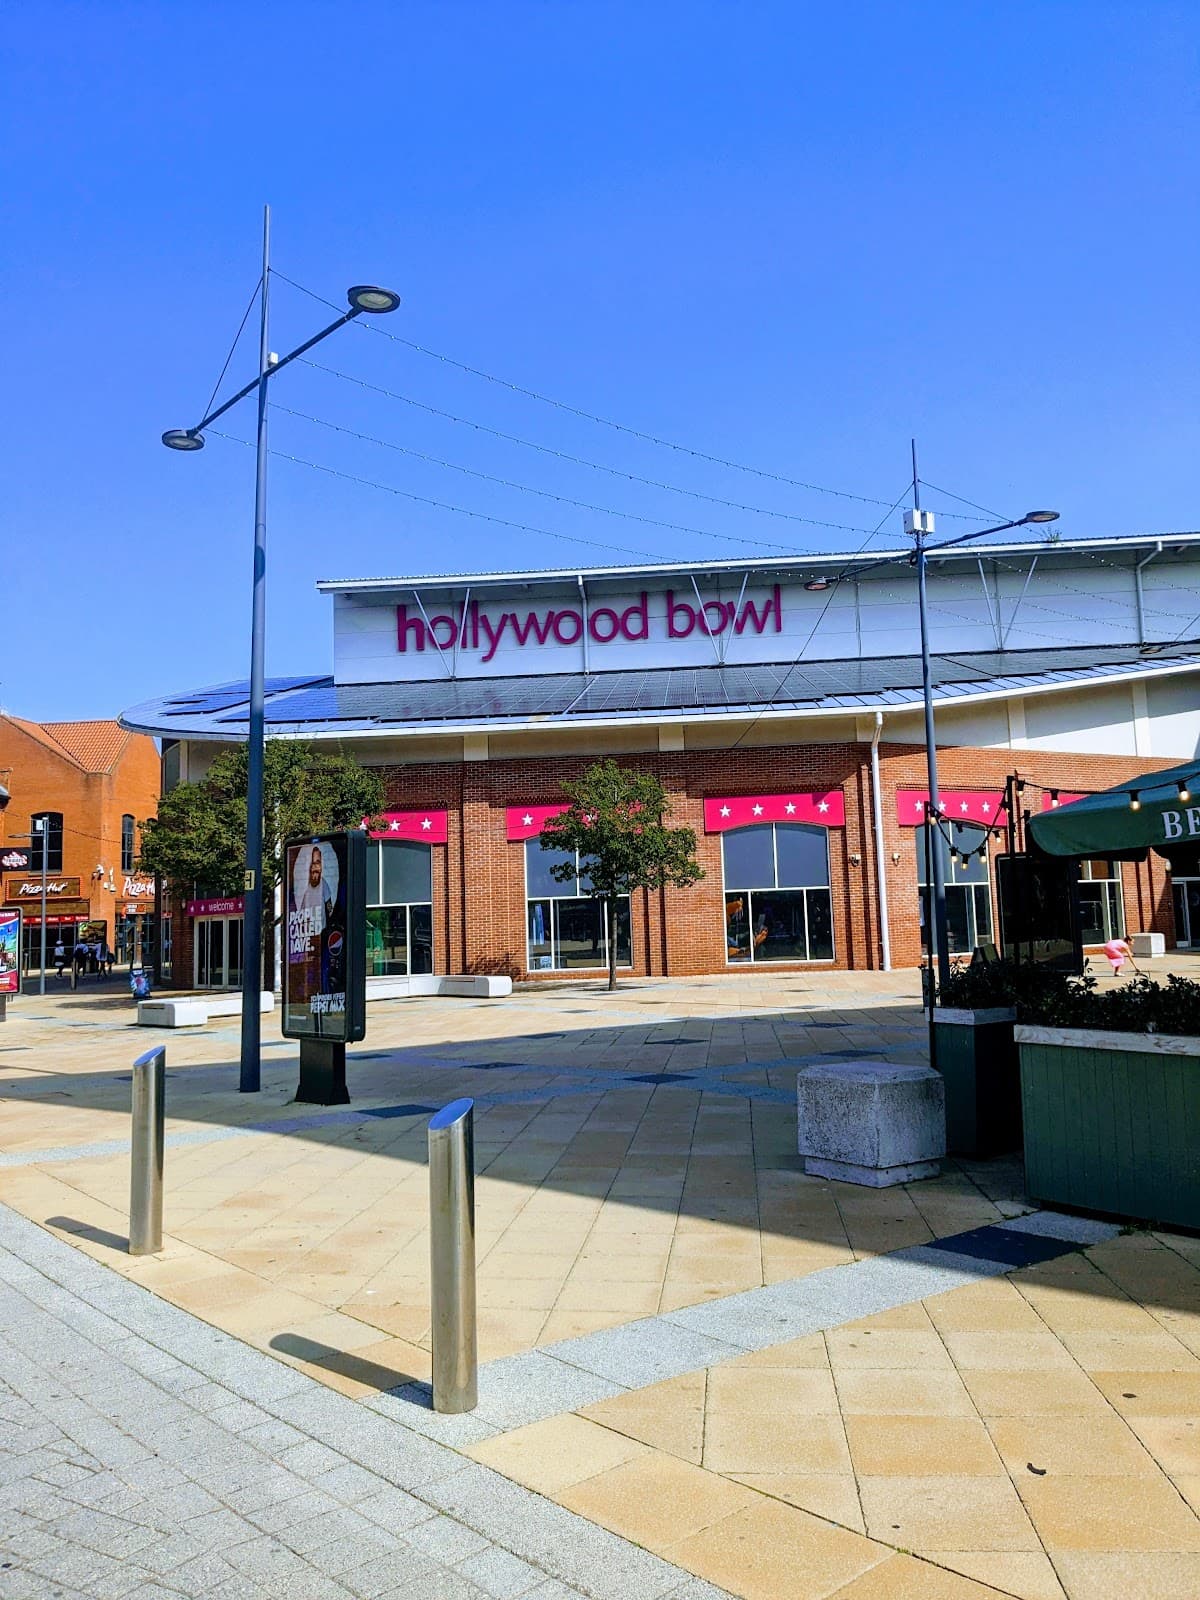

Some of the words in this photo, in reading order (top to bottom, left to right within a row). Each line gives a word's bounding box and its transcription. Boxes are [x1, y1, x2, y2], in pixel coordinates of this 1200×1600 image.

[396, 591, 649, 662] hollywood
[666, 583, 782, 638] bowl
[46, 882, 64, 893] Hut
[122, 876, 145, 897] Pizza
[208, 901, 235, 912] welcome
[289, 905, 322, 925] PEOPLE
[289, 921, 323, 940] CALLED
[329, 1000, 346, 1012] MAX
